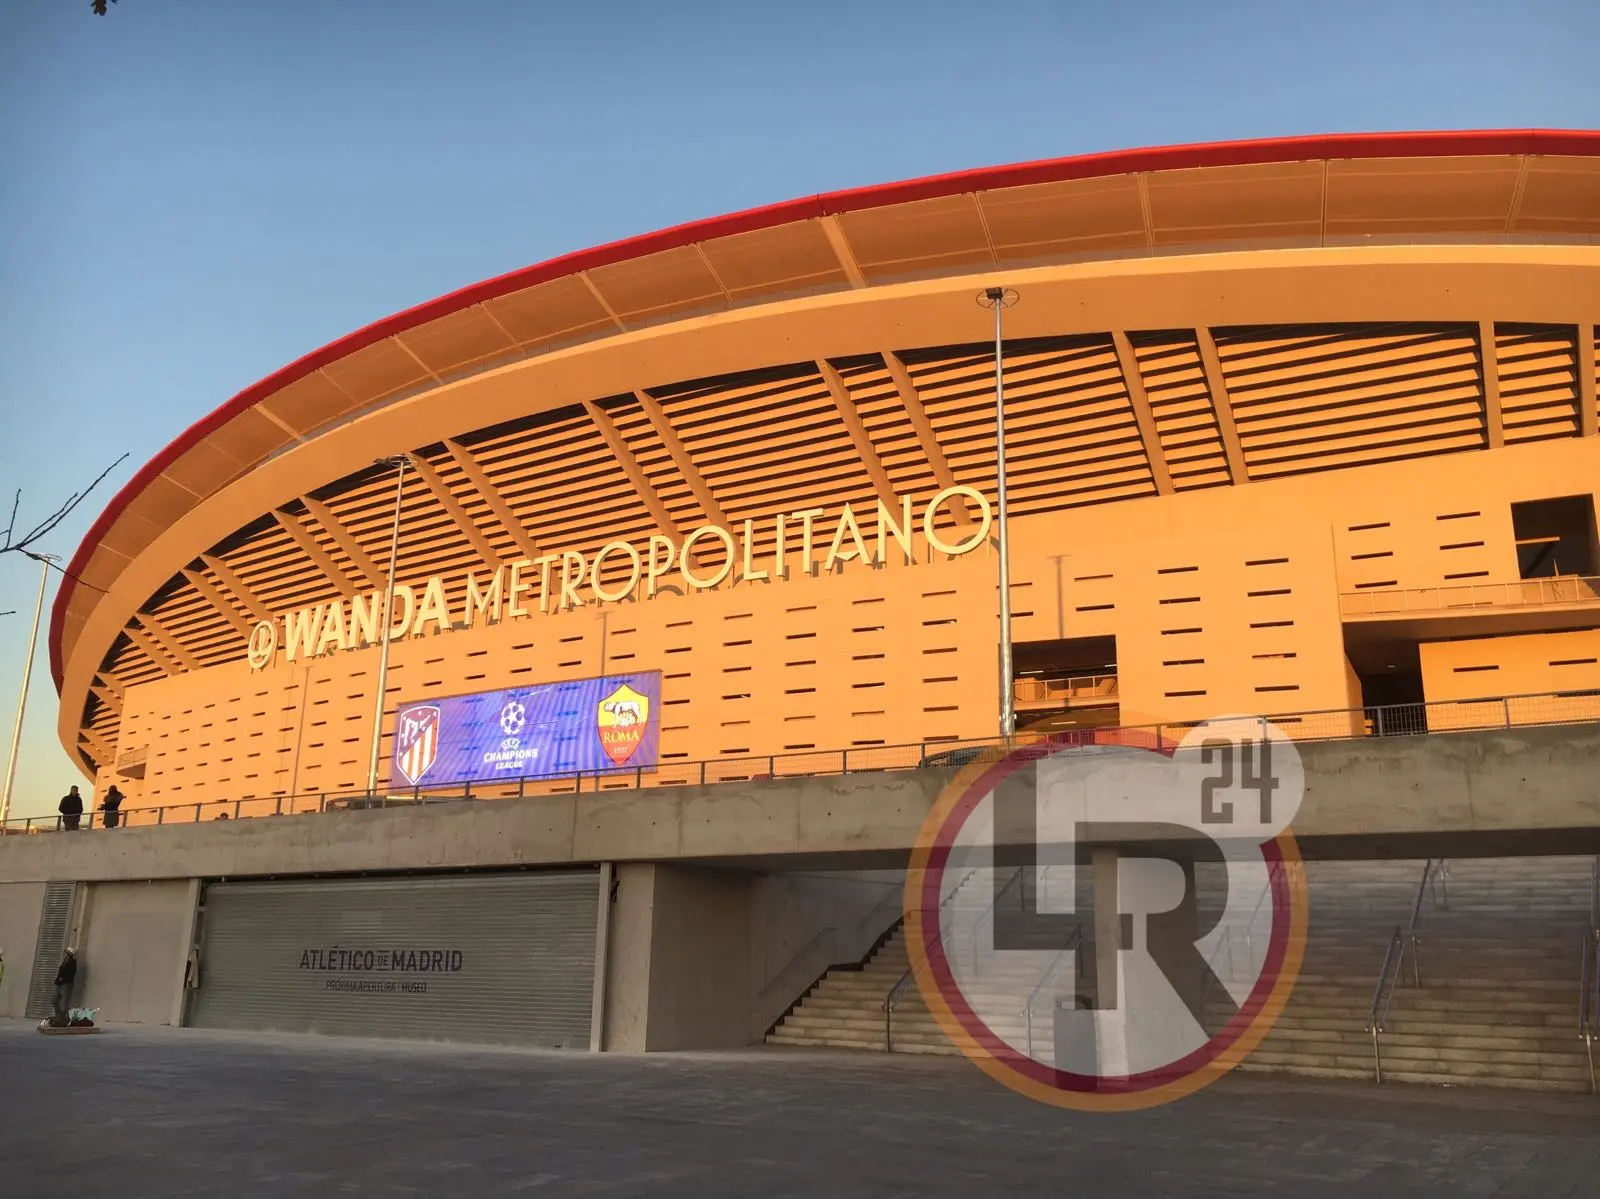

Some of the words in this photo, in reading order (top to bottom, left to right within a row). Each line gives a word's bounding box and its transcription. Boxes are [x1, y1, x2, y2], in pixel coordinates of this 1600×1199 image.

[284, 576, 451, 662] WANDA
[464, 485, 992, 625] METROPOLITANO
[603, 730, 640, 743] ROMA
[483, 748, 538, 763] CHAMPIONS
[495, 760, 524, 770] LEAGUE
[300, 944, 374, 970] ATLÉTICO
[377, 955, 388, 966] DE
[391, 950, 463, 972] MADRID
[401, 981, 427, 993] MUSEO
